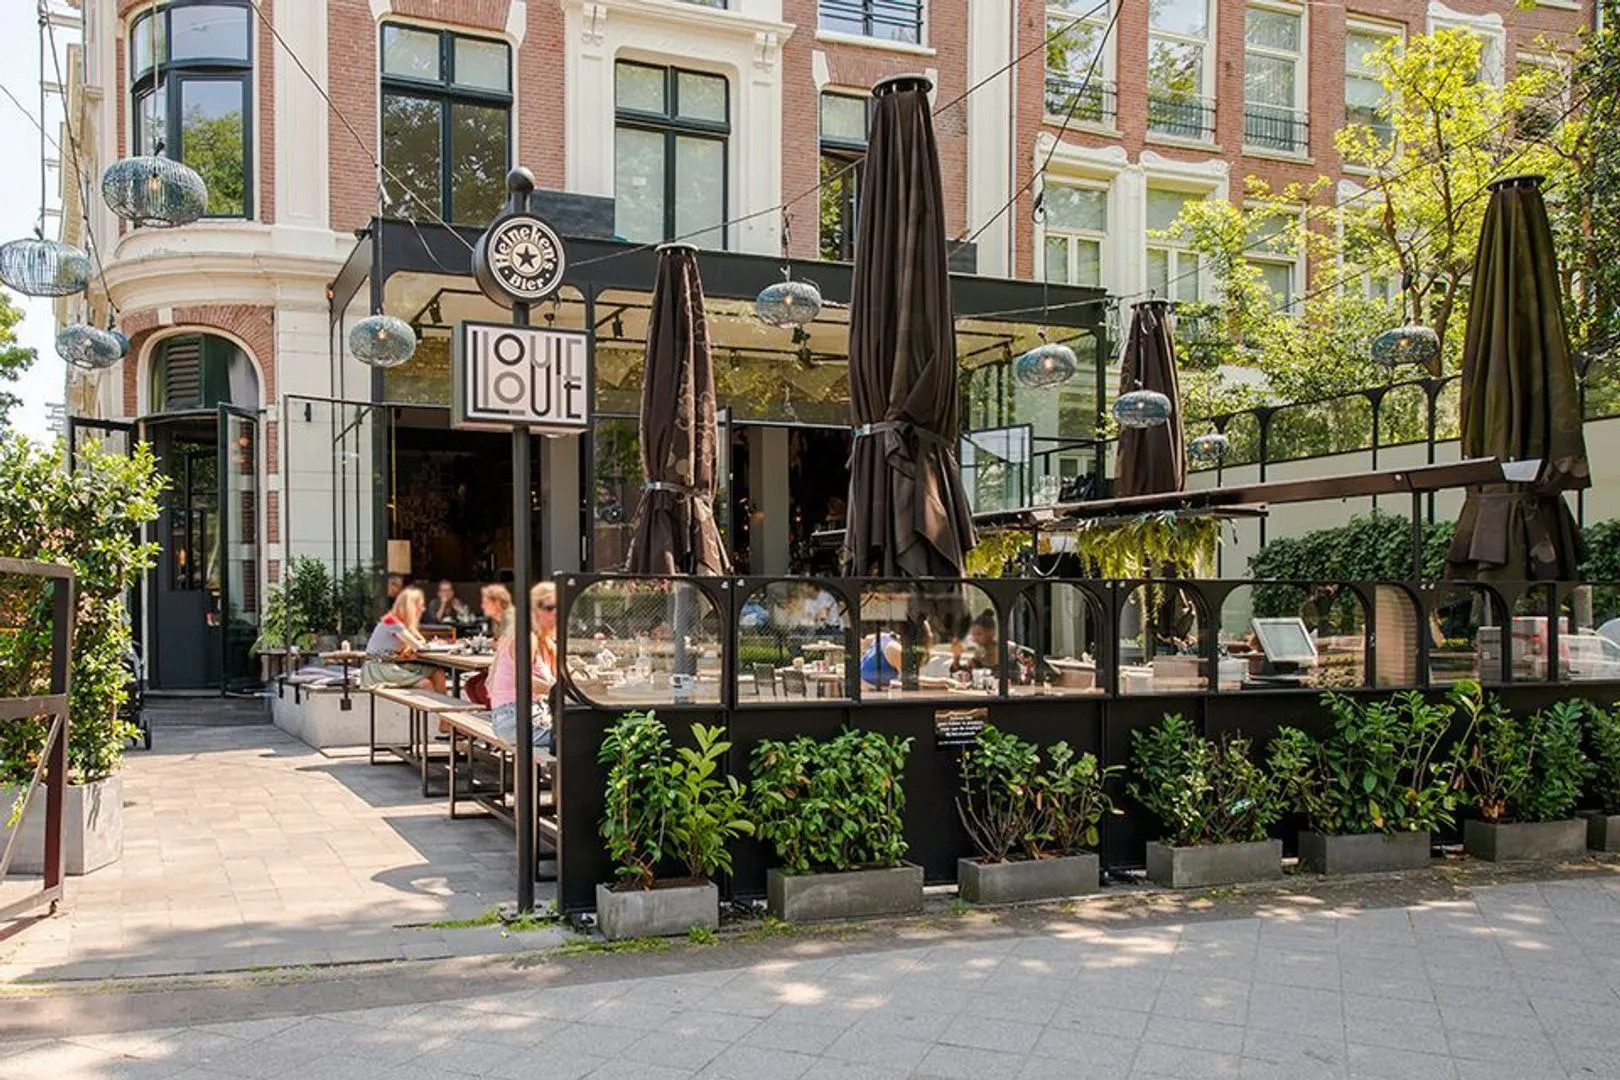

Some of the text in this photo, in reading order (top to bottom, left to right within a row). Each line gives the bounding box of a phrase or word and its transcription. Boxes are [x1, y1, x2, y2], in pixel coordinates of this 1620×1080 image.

[495, 226, 557, 270] Heineken's
[509, 271, 545, 291] Bier
[472, 331, 582, 419] LOUIE
